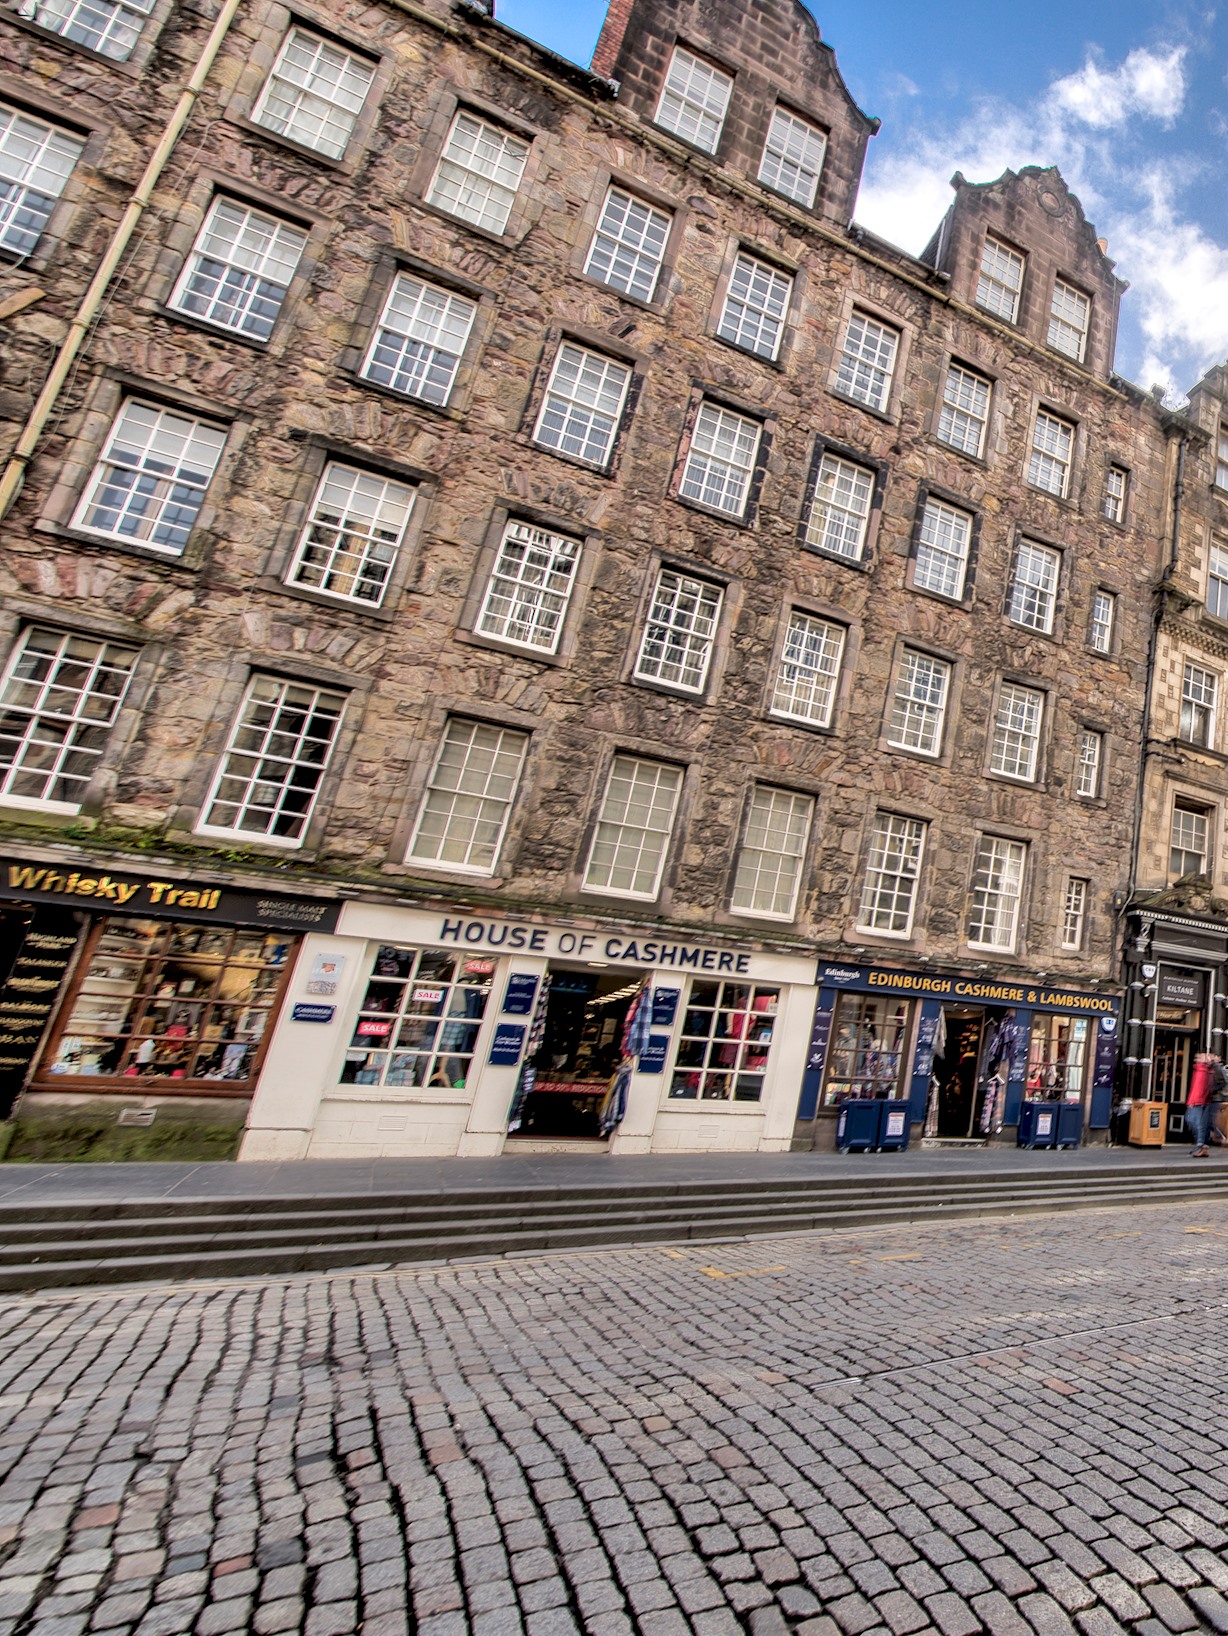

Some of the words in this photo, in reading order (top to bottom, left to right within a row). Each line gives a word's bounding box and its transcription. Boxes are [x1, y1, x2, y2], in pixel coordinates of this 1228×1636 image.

[8, 865, 141, 905] Whisky
[147, 881, 222, 910] Trail
[439, 918, 549, 951] HOUSE
[557, 932, 598, 955] OF
[604, 938, 752, 974] CASHMERE
[469, 962, 491, 971] SALE
[417, 991, 440, 999] SALE
[824, 967, 861, 979] Edinburgh
[868, 972, 952, 993] EDINBURGH
[954, 981, 1024, 1002] CASHMERE
[1027, 990, 1037, 1002] &
[1040, 992, 1114, 1012] LAMBSWOOL
[1167, 985, 1195, 996] KILTANE
[363, 1023, 388, 1033] SALE
